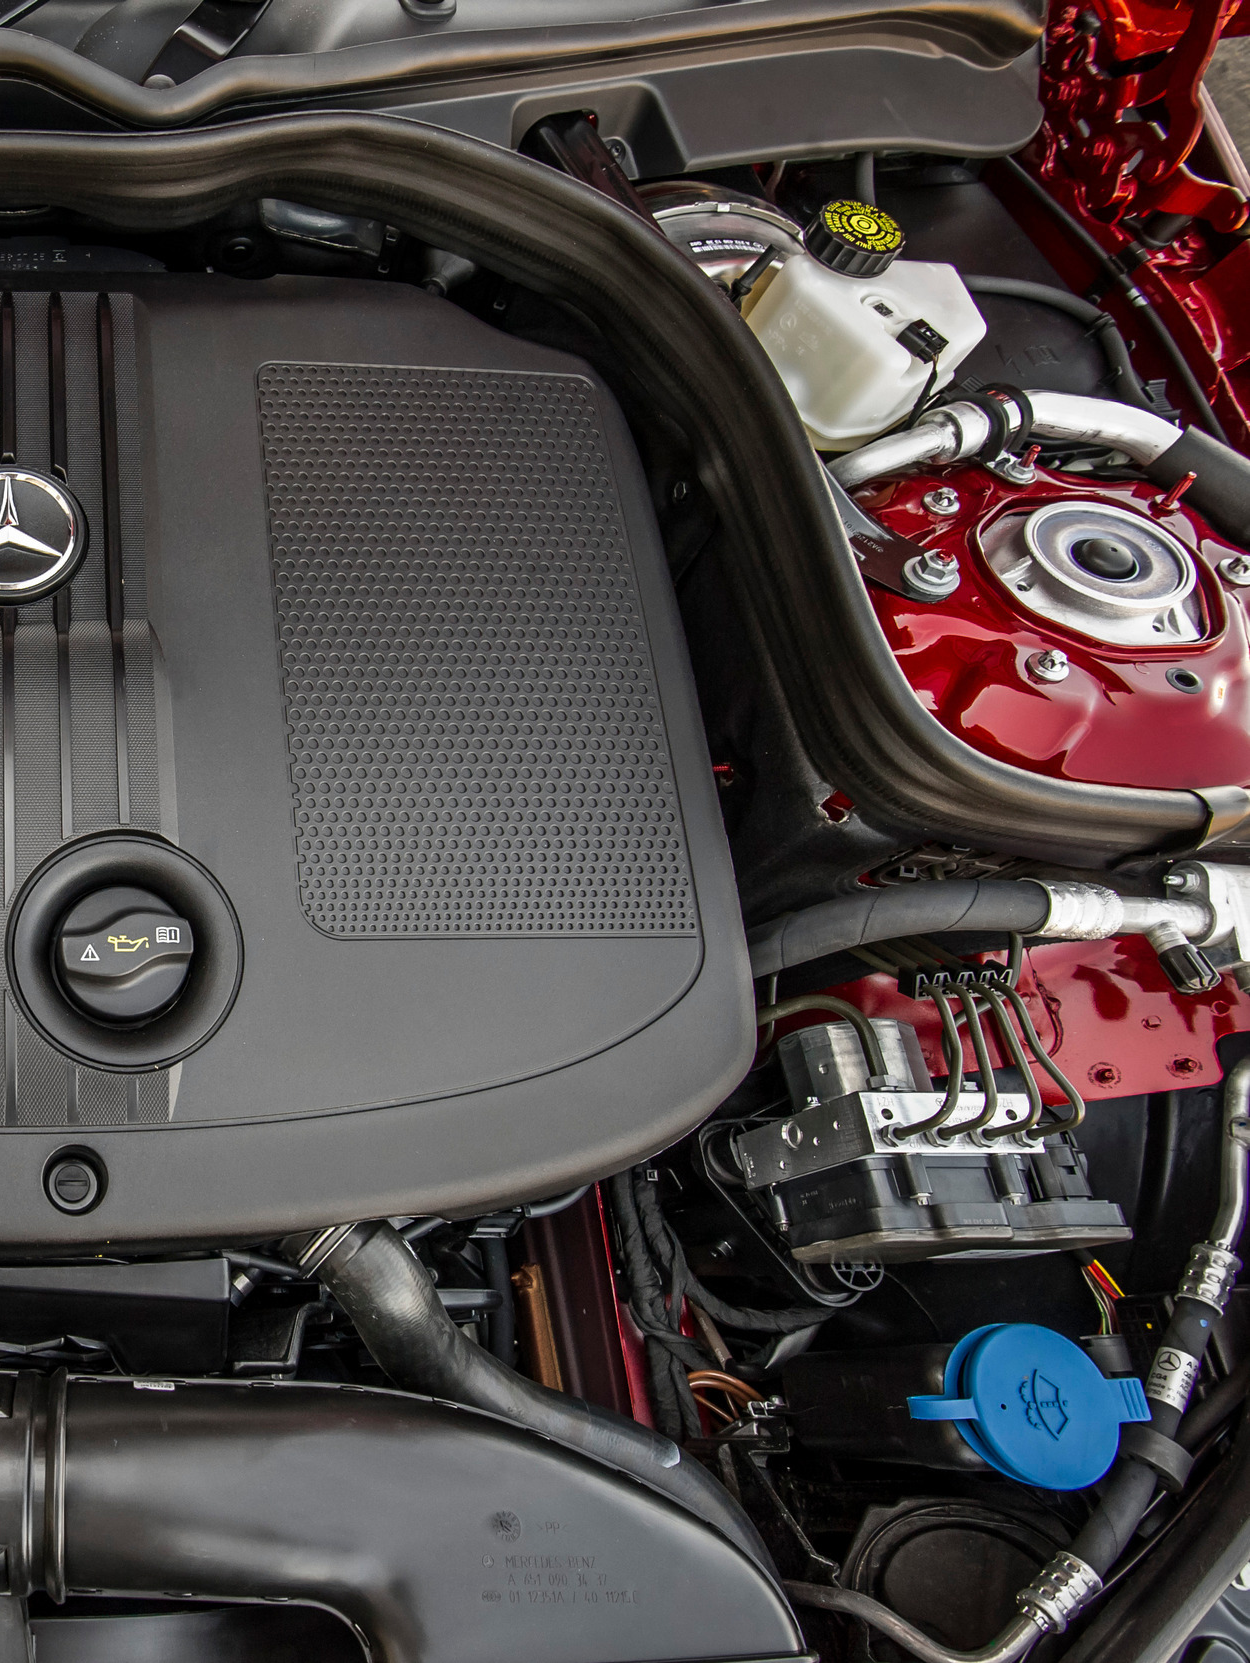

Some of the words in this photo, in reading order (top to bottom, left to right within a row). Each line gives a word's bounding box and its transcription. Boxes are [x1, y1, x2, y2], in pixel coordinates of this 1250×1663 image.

[842, 233, 856, 242] DOT
[855, 241, 872, 250] ONLY
[508, 1574, 516, 1586] A
